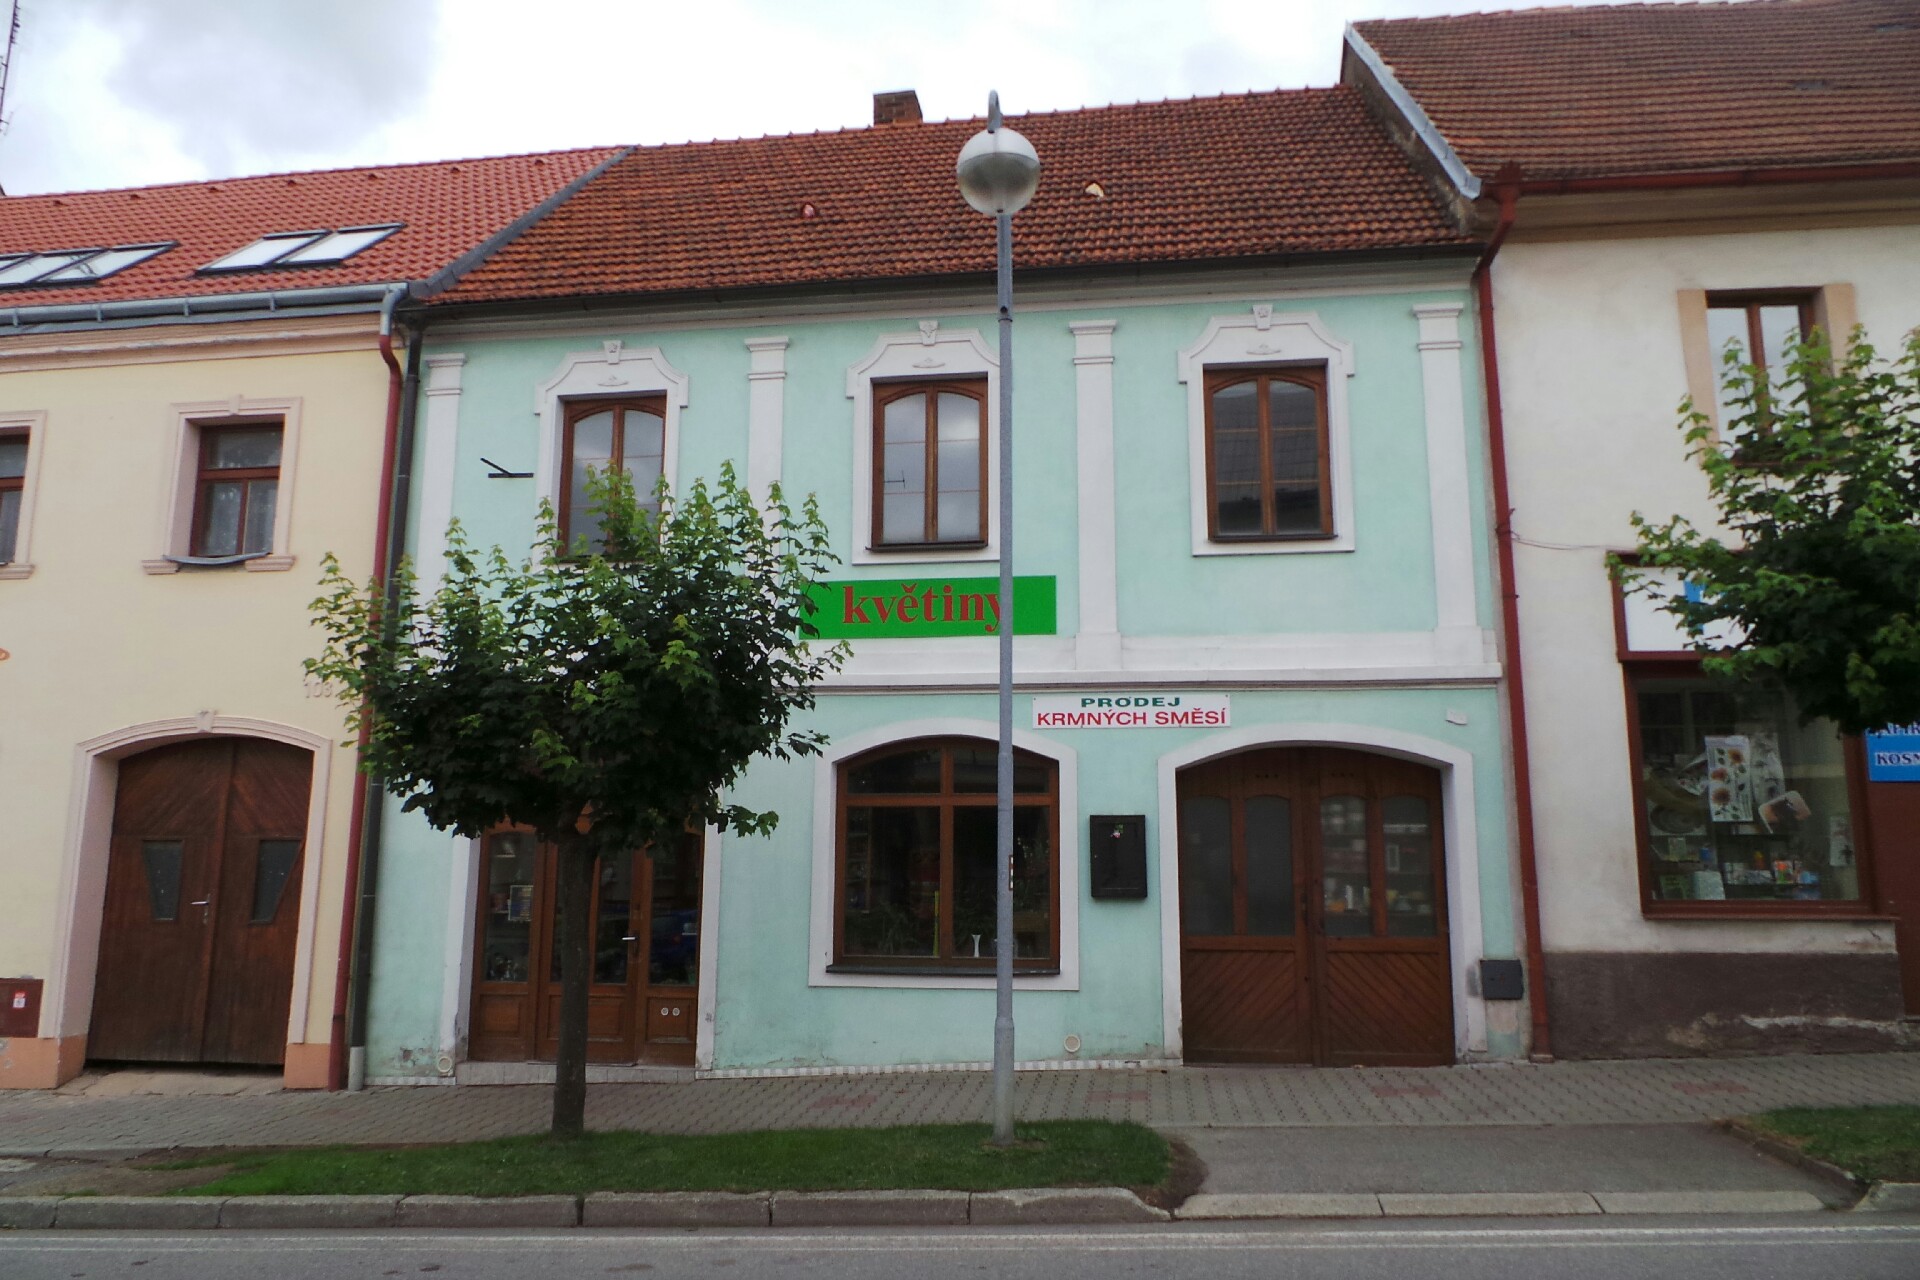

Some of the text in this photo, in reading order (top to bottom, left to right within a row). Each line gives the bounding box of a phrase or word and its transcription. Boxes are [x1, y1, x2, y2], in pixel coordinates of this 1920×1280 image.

[842, 583, 1000, 632] květiny
[1081, 697, 1181, 708] PRODEJ
[1037, 707, 1226, 726] KRMNÝCH SMĚSÍ
